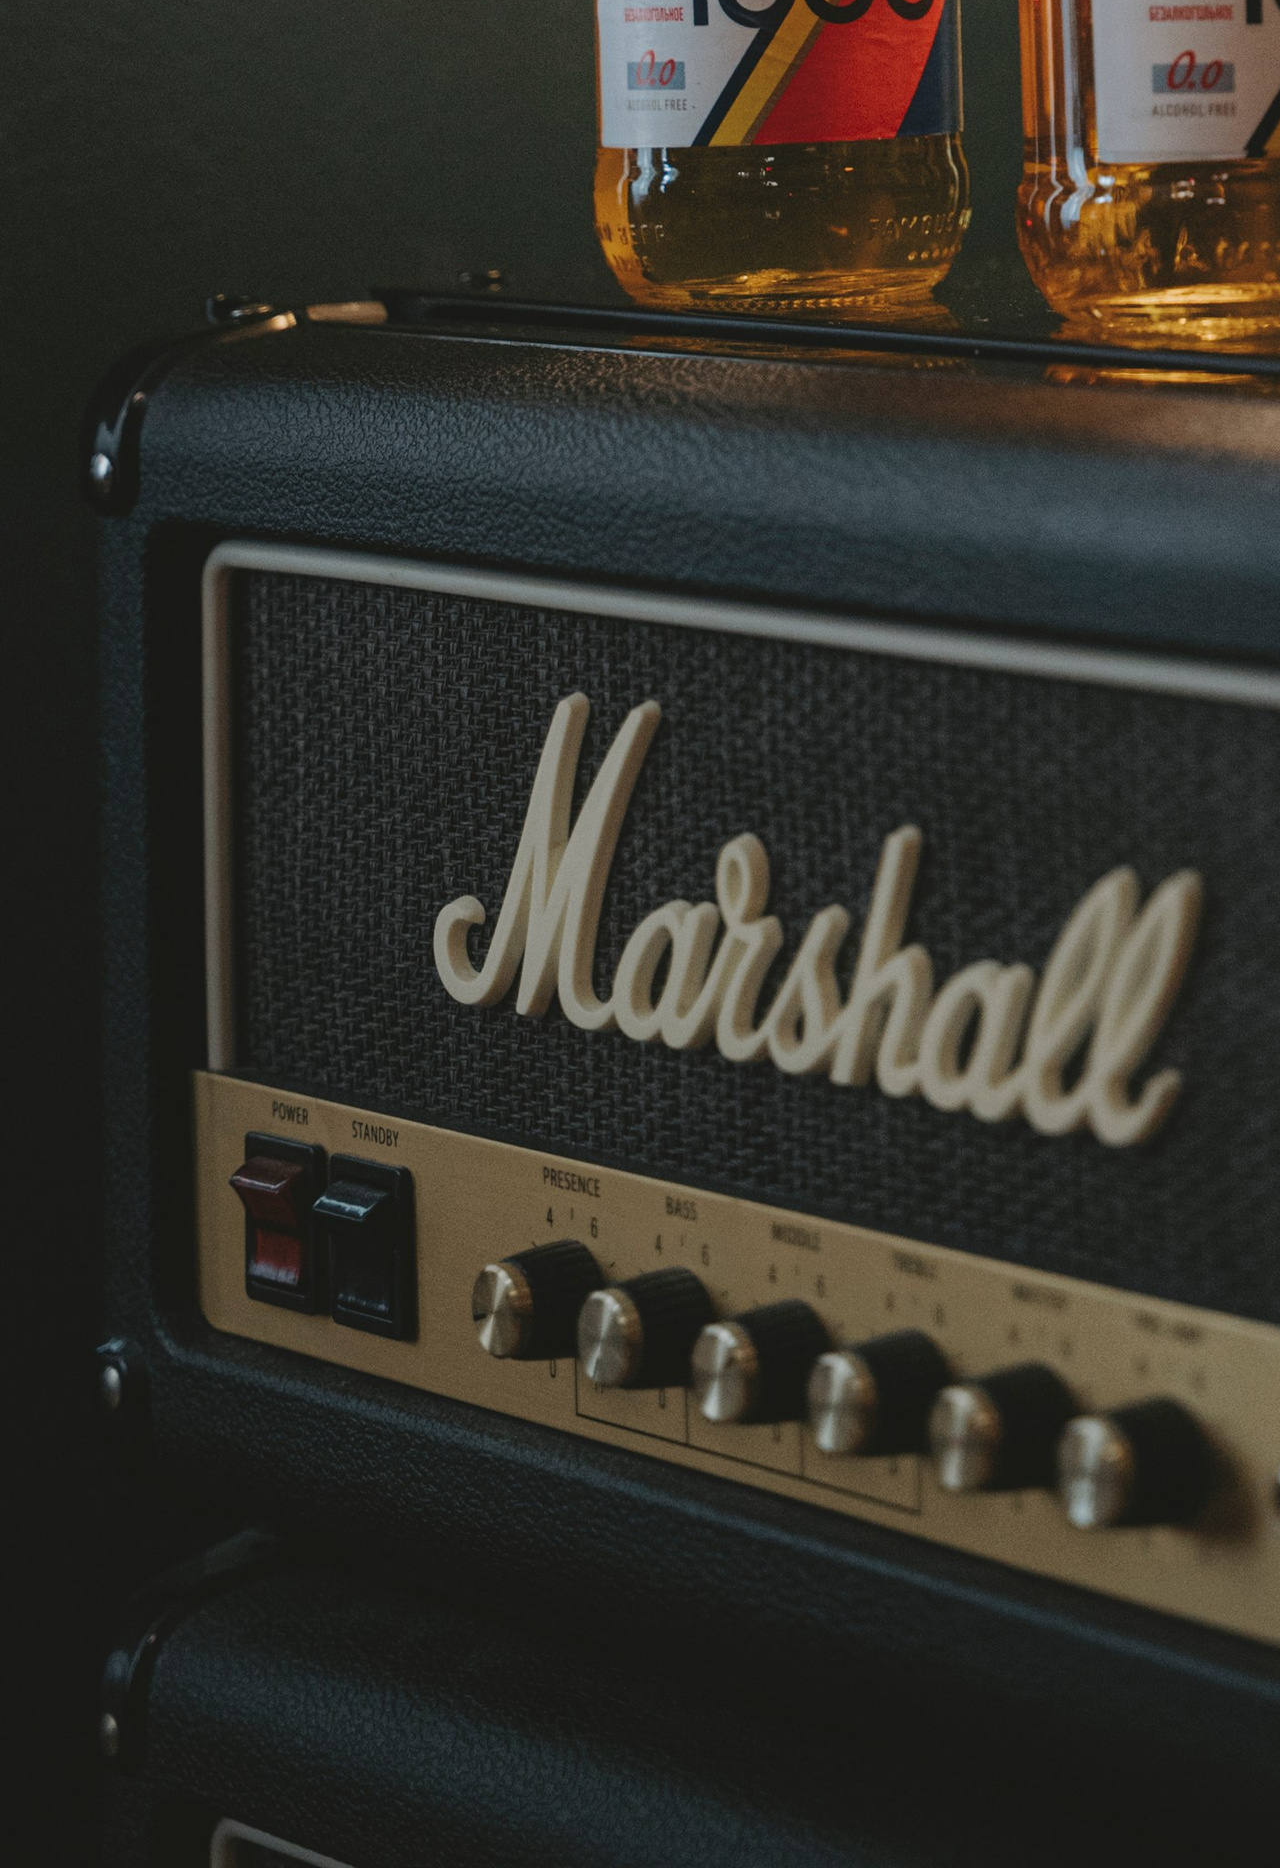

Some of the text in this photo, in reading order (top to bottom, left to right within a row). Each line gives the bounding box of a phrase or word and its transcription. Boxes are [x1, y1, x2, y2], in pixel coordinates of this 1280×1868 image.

[636, 48, 676, 87] 0.0
[1167, 49, 1224, 91] 0.0
[664, 98, 688, 111] FREE
[433, 690, 1200, 1147] Marshall
[272, 1100, 309, 1127] POWER
[351, 1120, 399, 1148] STANDBY
[542, 1165, 600, 1199] PRESENCE
[546, 1206, 599, 1239] 4 6
[666, 1195, 697, 1221] BASS
[654, 1234, 662, 1256] 4
